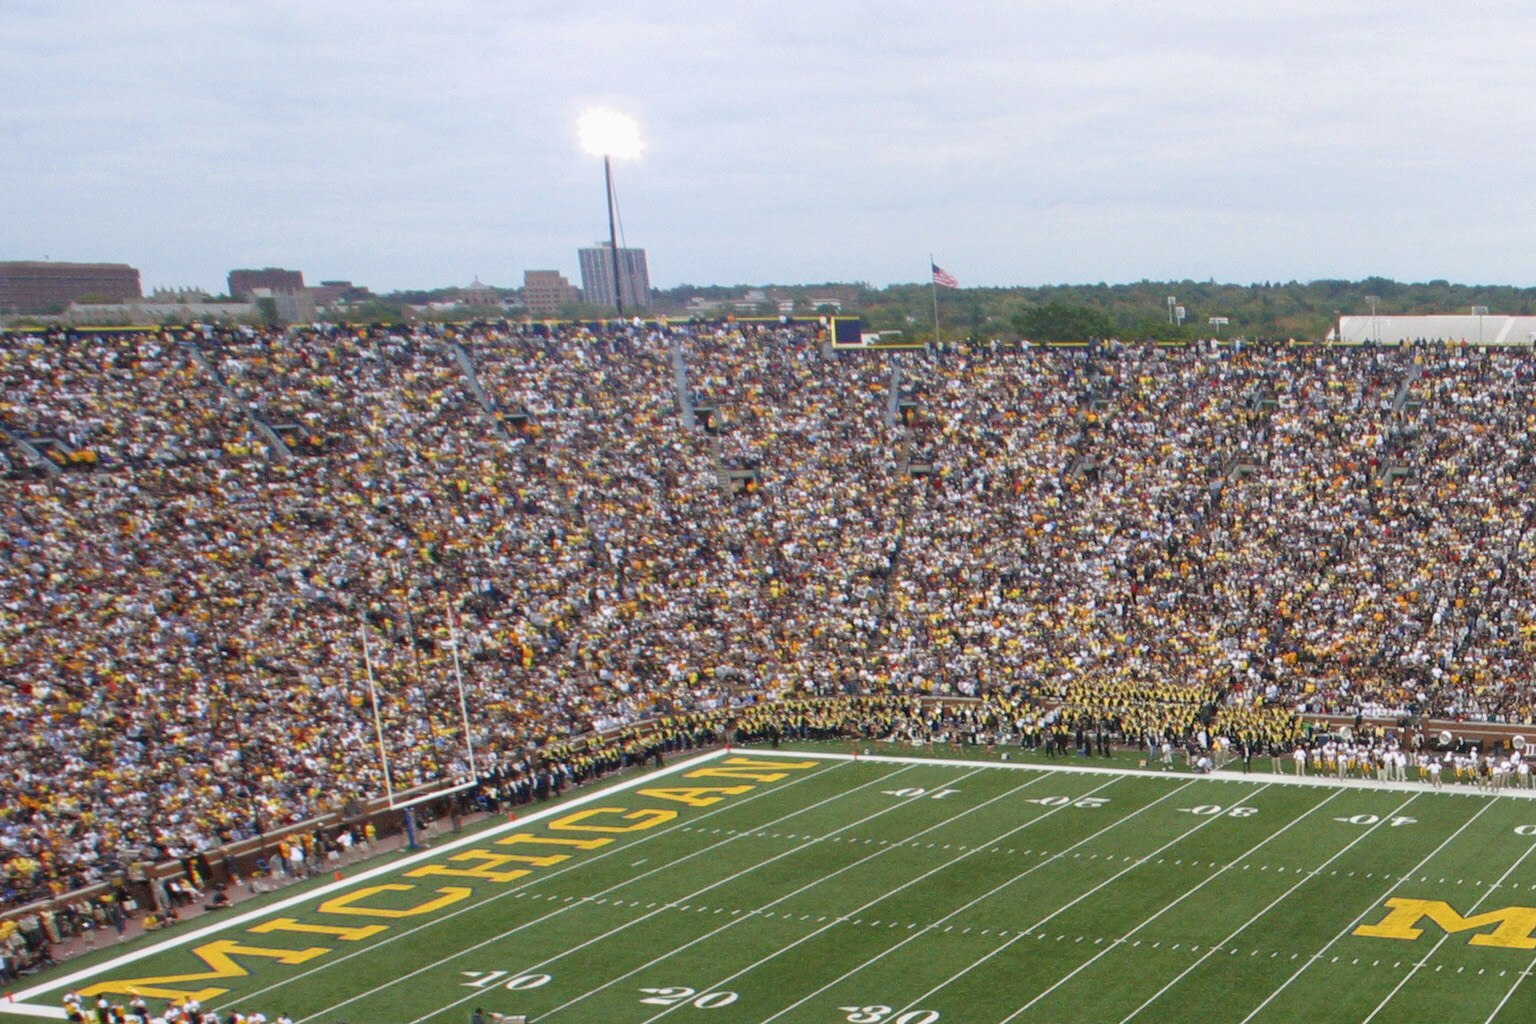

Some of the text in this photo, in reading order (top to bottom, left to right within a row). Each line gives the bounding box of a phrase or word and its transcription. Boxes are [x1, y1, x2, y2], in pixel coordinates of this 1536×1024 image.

[79, 756, 820, 1006] MICHIGAN
[460, 970, 551, 990] 10
[639, 986, 739, 1009] 20
